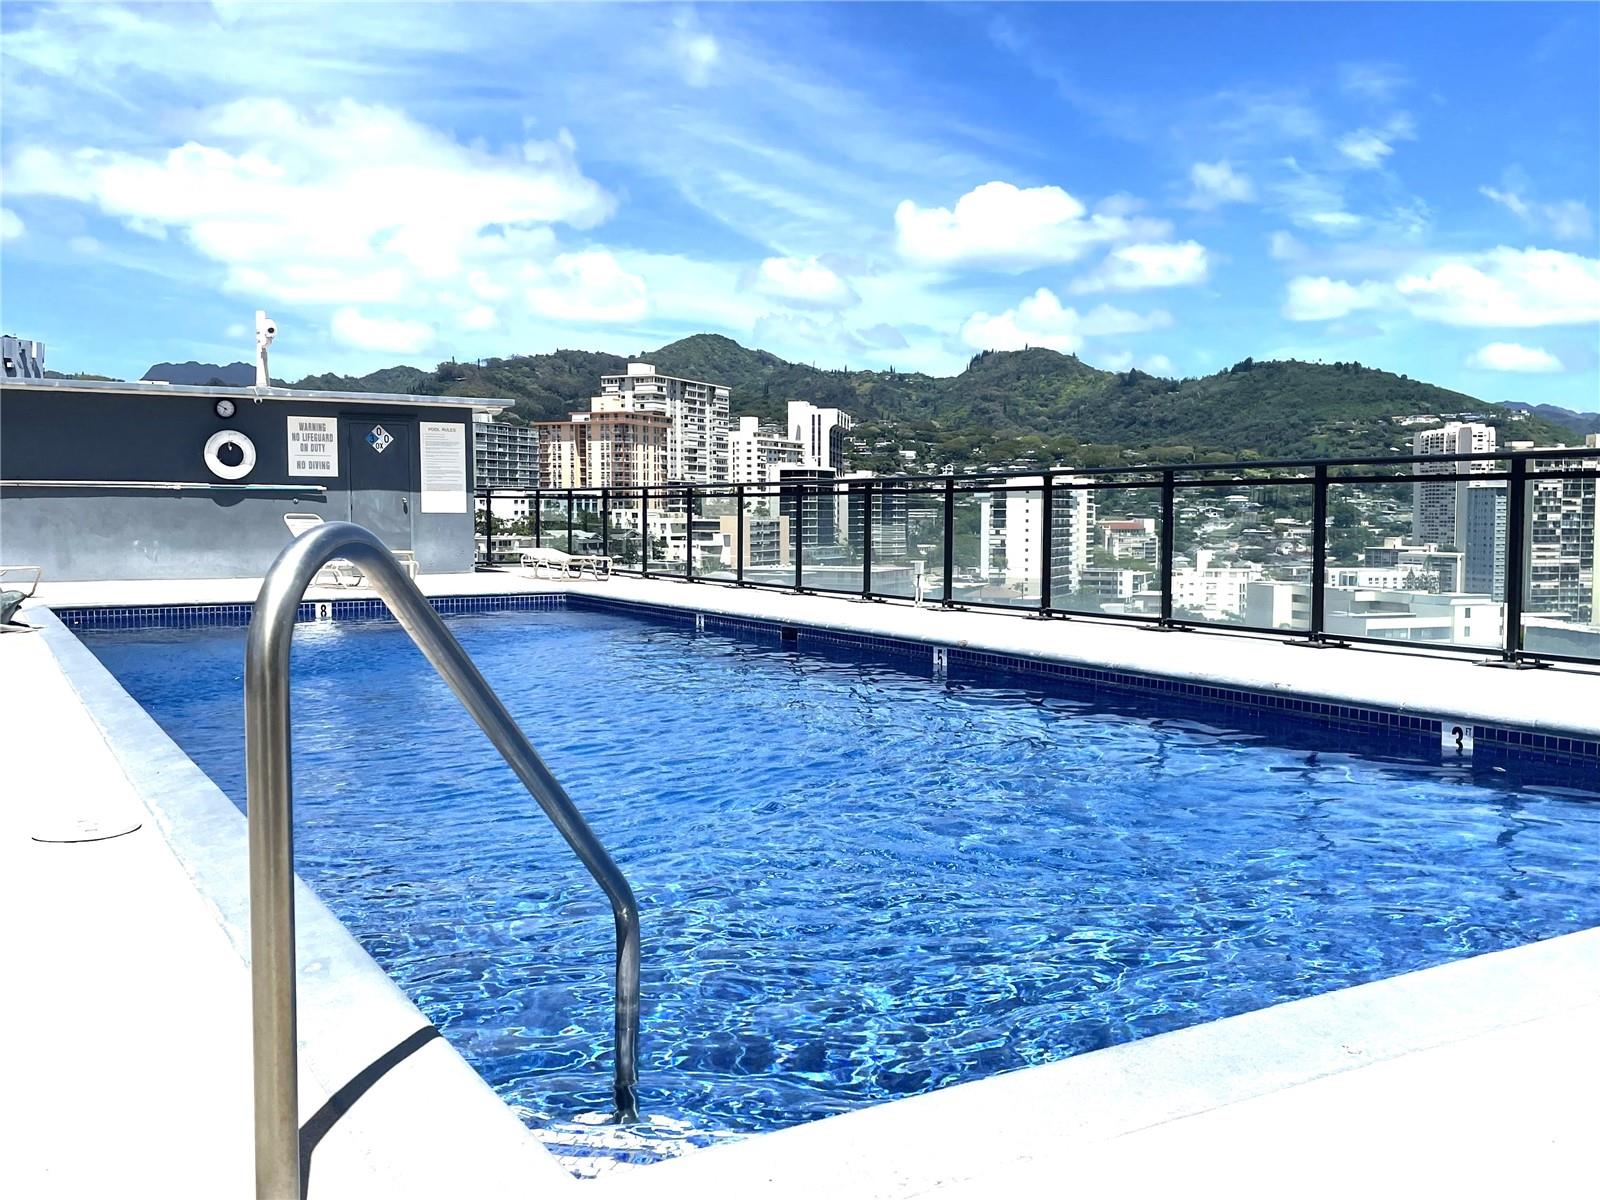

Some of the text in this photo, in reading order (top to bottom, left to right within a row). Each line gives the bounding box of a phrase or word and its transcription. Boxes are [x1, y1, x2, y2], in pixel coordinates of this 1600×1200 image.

[299, 422, 327, 432] WARNING
[291, 432, 334, 443] NO LIFEGUARD
[300, 443, 326, 453] ON DUTY
[296, 460, 331, 470] NO DIVING
[320, 604, 327, 618] 8
[1451, 726, 1464, 752] 3
